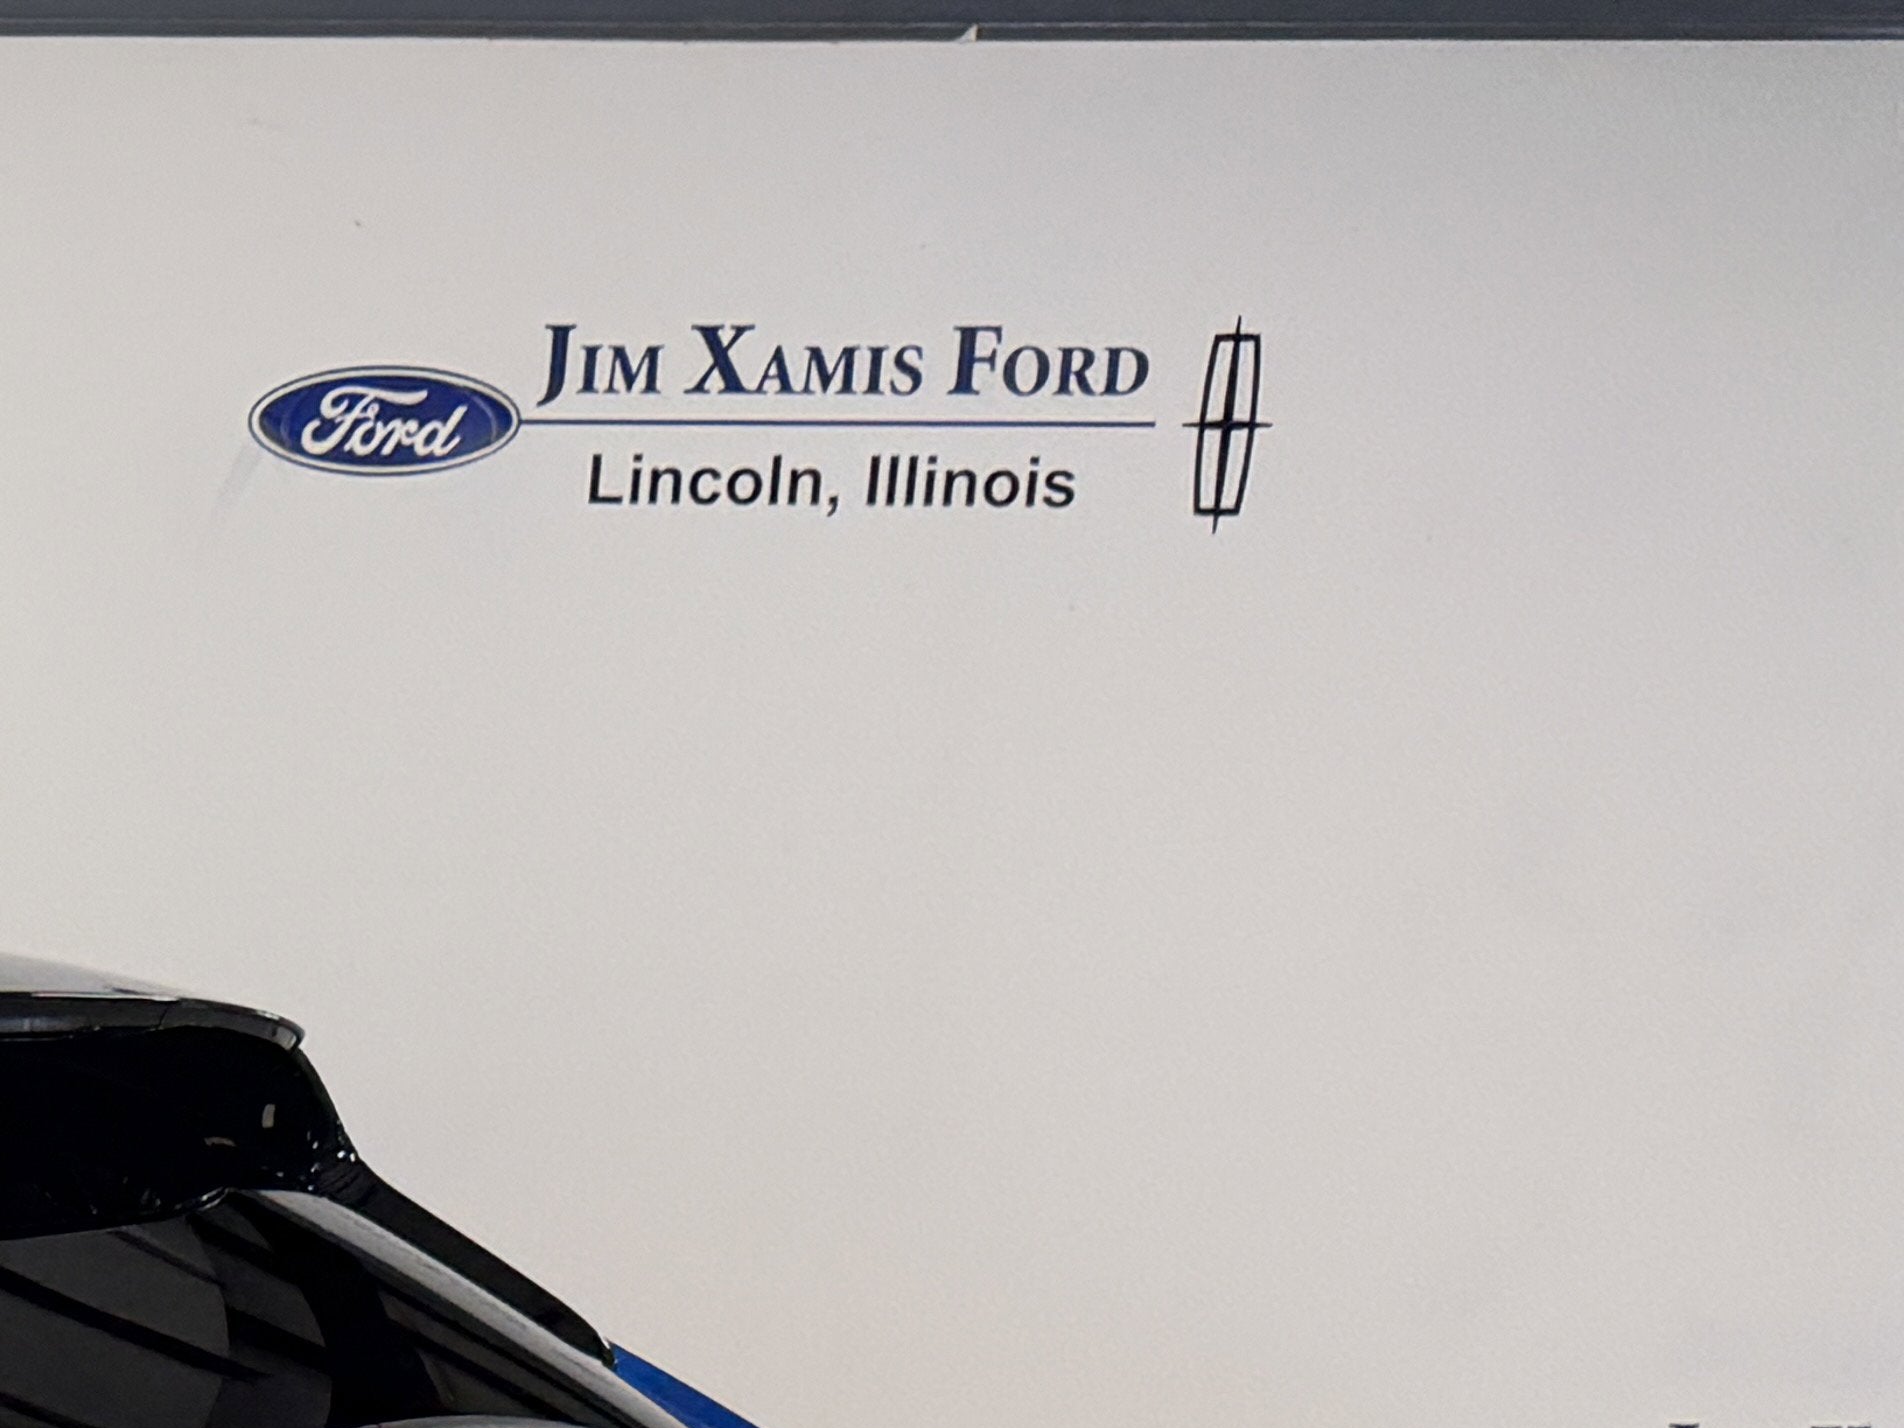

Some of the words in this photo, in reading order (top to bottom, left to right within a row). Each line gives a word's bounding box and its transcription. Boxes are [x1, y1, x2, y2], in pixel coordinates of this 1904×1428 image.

[536, 323, 664, 408] JIM
[683, 324, 923, 396] XAMIS
[947, 325, 1149, 397] FORD
[300, 384, 469, 457] Ford
[588, 453, 839, 517] Lincoln,
[866, 454, 1075, 509] Illinois
